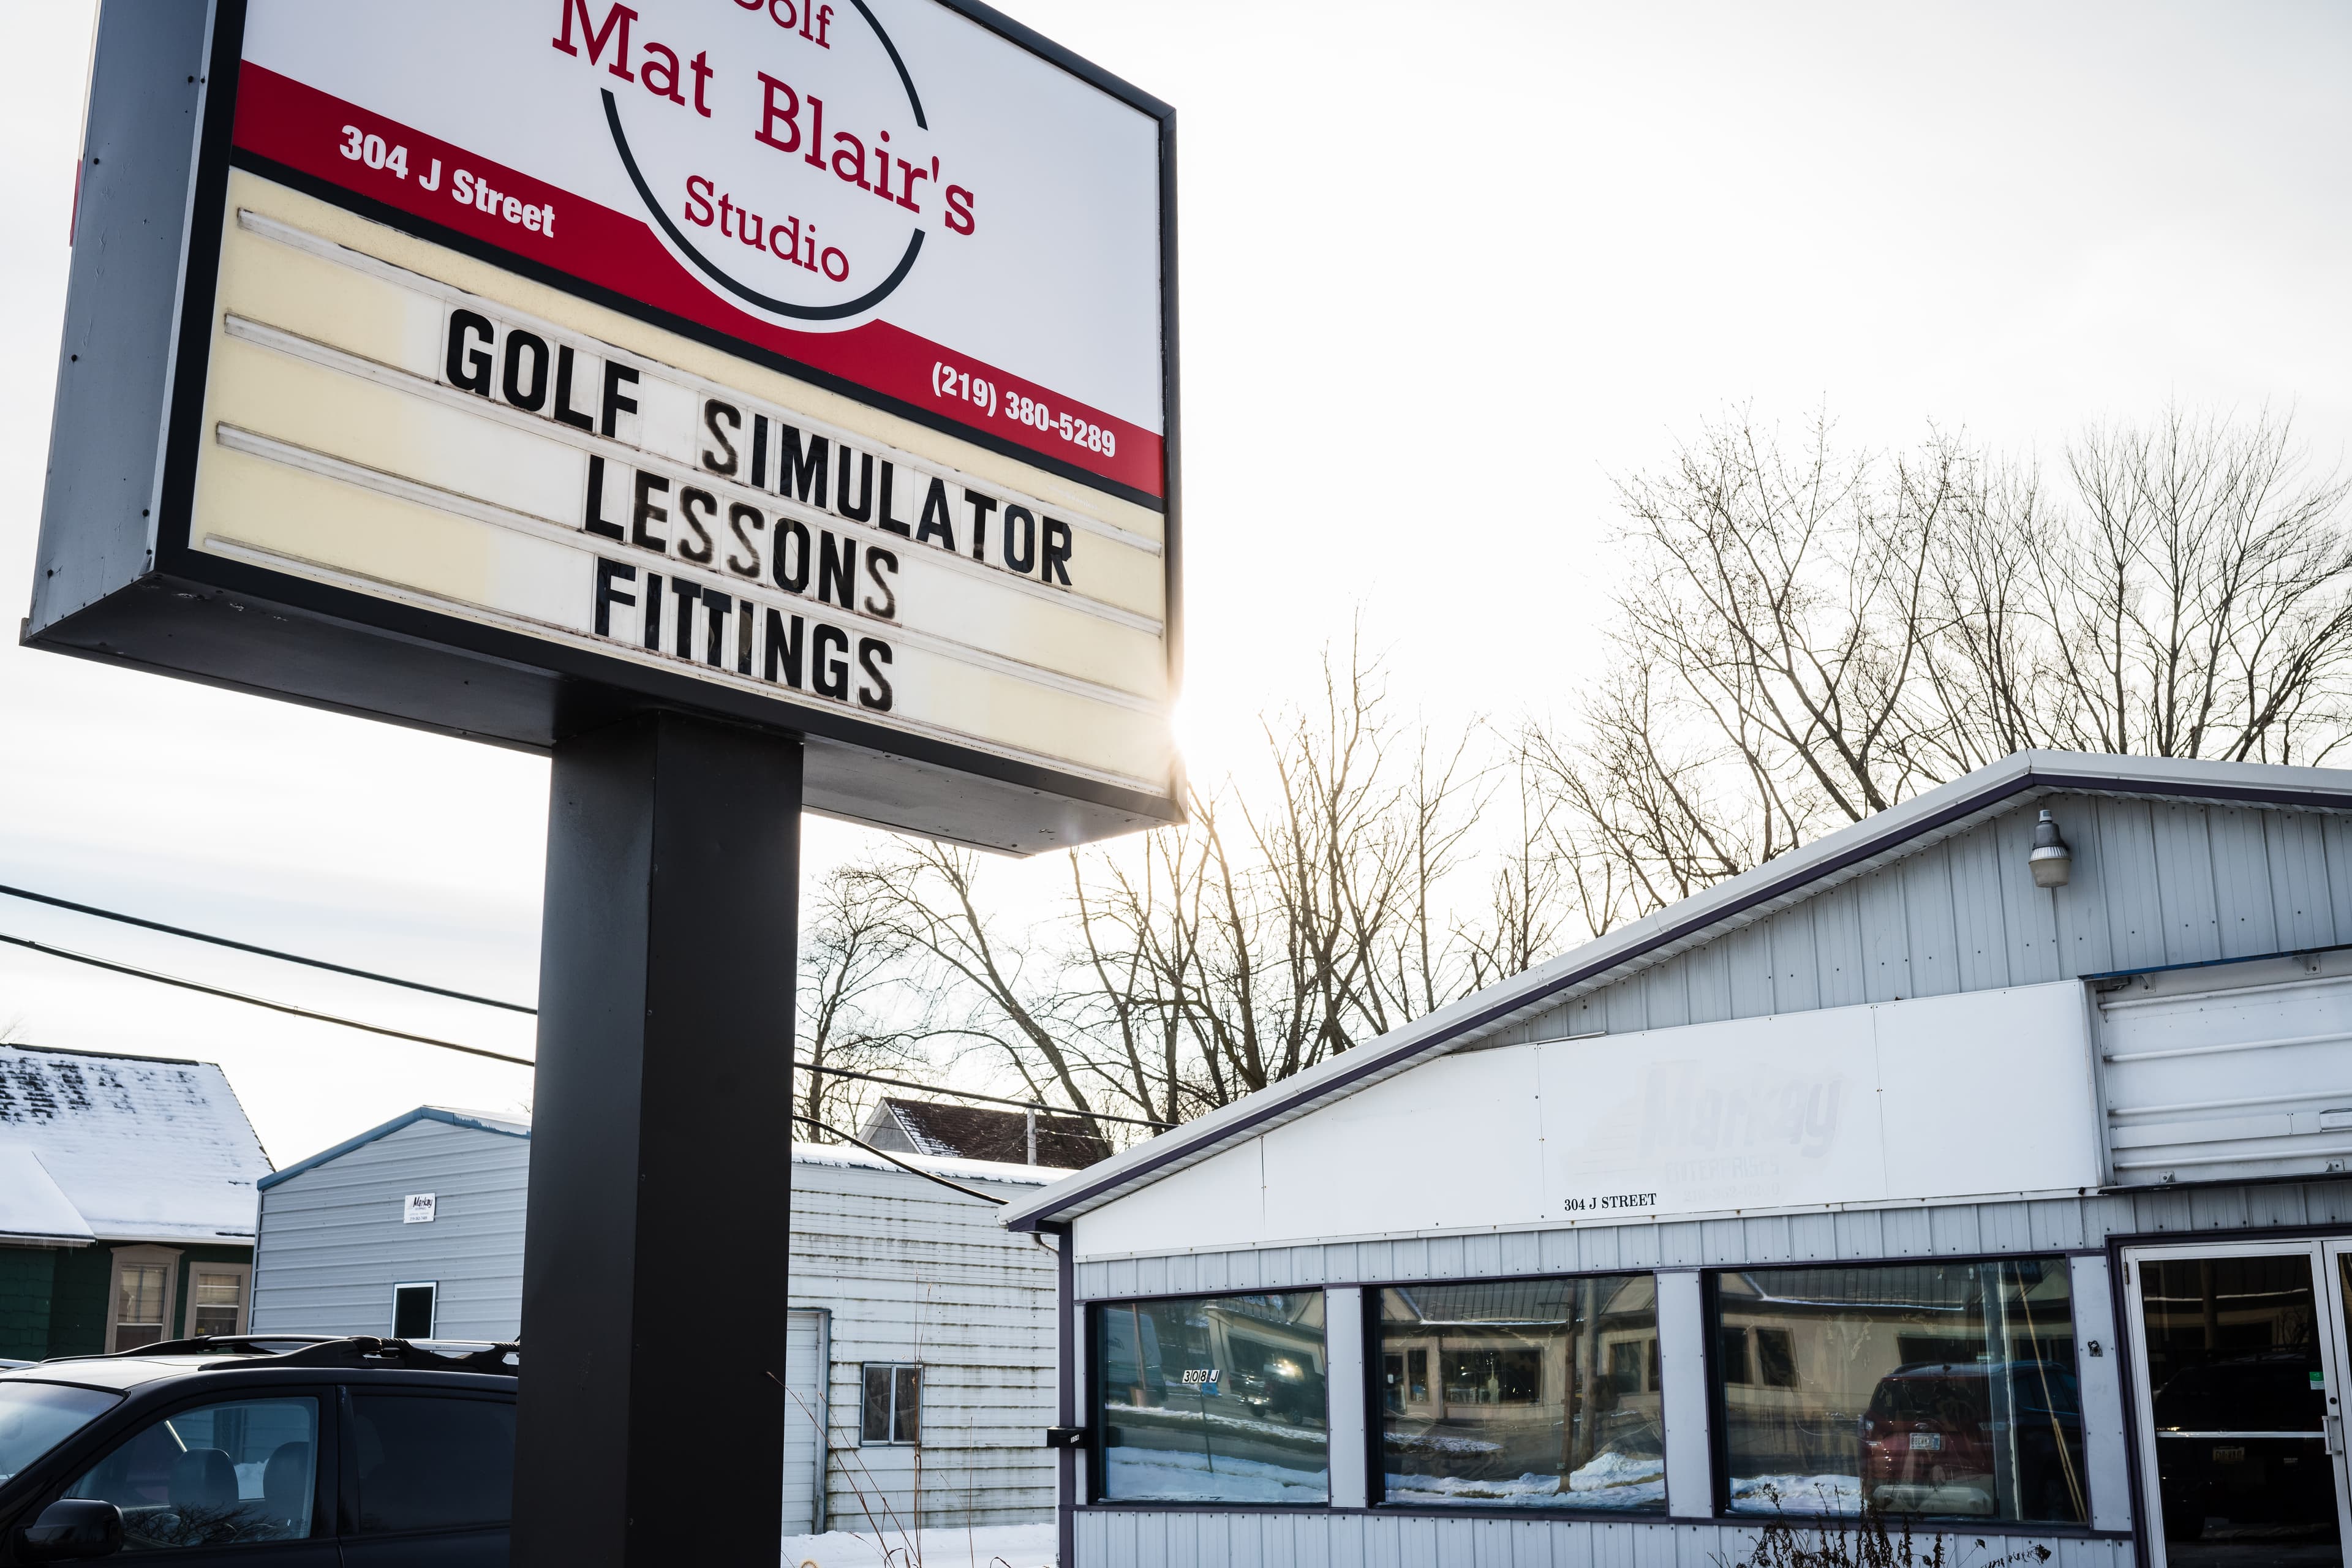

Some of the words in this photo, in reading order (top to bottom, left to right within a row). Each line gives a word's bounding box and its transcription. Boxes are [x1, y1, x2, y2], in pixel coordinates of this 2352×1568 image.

[733, 0, 834, 50] olf
[552, 0, 714, 118] Mat
[755, 70, 975, 236] Blair's
[340, 125, 409, 179] 304
[419, 158, 442, 191] J
[452, 169, 555, 238] Street
[685, 175, 850, 282] Studio
[445, 308, 641, 439] GOLF
[701, 398, 1073, 587] SIMULATOR
[932, 361, 997, 417] (219)
[1005, 391, 1115, 458] 380-5289
[584, 454, 899, 620] LESSONS
[594, 556, 894, 712] FITTINGS
[1564, 1199, 1586, 1211] 304
[1589, 1197, 1597, 1210] J
[1602, 1193, 1657, 1208] STREET
[1183, 1370, 1207, 1382] 308
[1210, 1370, 1219, 1382] J
